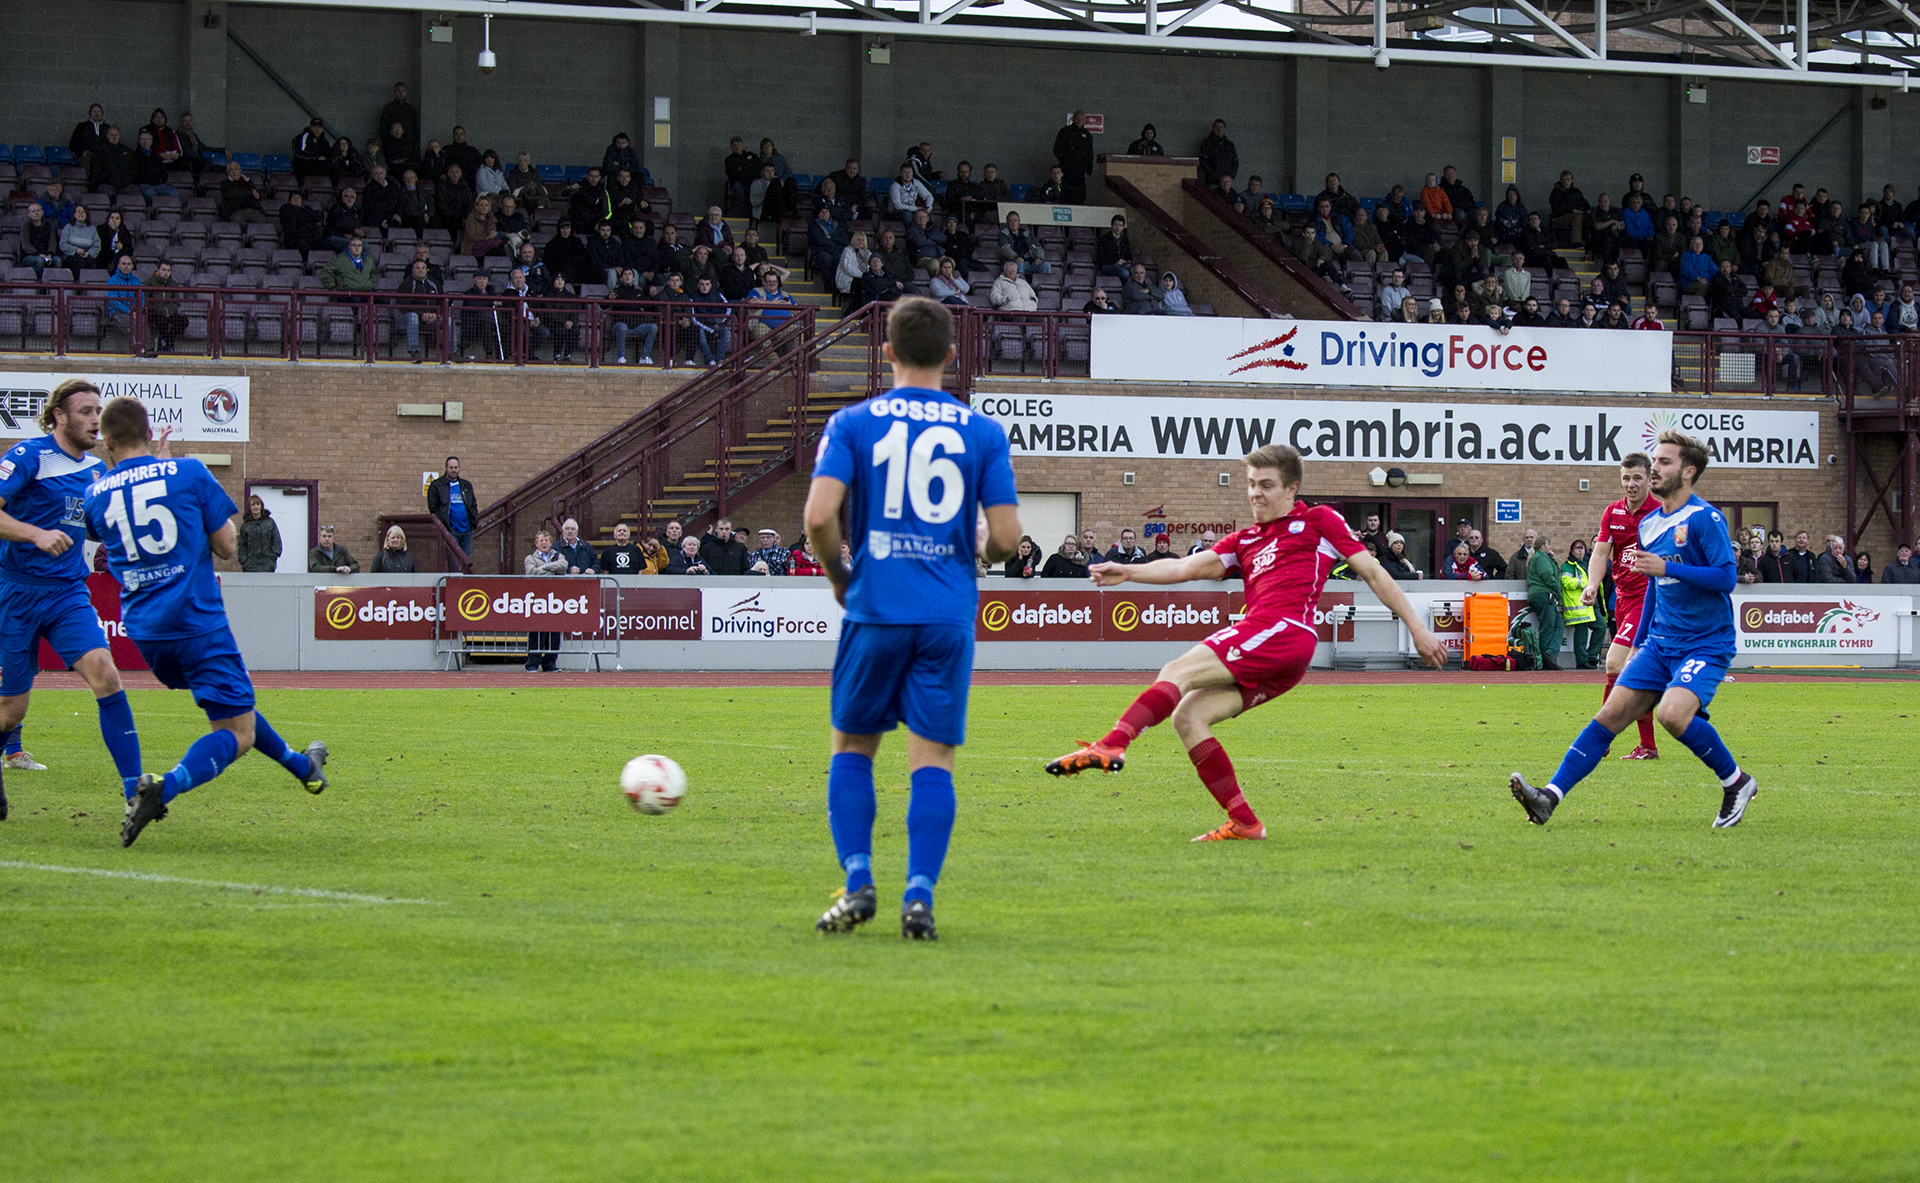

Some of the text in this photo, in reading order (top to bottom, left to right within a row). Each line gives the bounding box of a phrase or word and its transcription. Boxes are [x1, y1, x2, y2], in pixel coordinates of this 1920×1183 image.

[1320, 330, 1548, 377] DrivingForce
[147, 407, 183, 424] HAM
[869, 398, 973, 426] GOSSET
[981, 397, 1053, 417] COLEG
[1681, 413, 1745, 431] COLEG
[1008, 422, 1134, 453] AMBRIA
[1150, 408, 1622, 462] wwwcambria.ac.uk
[1704, 436, 1816, 465] AMBRIA
[872, 420, 966, 524] 16
[104, 479, 178, 562] 15
[892, 539, 956, 557] BANGOR
[138, 564, 186, 582] BANGOR
[358, 599, 446, 626] dafabet
[492, 592, 589, 618] dafabet
[1011, 603, 1092, 628] dafabet
[1141, 603, 1220, 628] dafabet
[1763, 609, 1815, 626] dafabet
[600, 610, 698, 636] personnel
[711, 615, 828, 638] DrivingForce
[1620, 622, 1634, 637] 7
[1744, 639, 1874, 648] UWCH GYNGHRAIR CYMRU
[1680, 659, 1707, 676] 27
